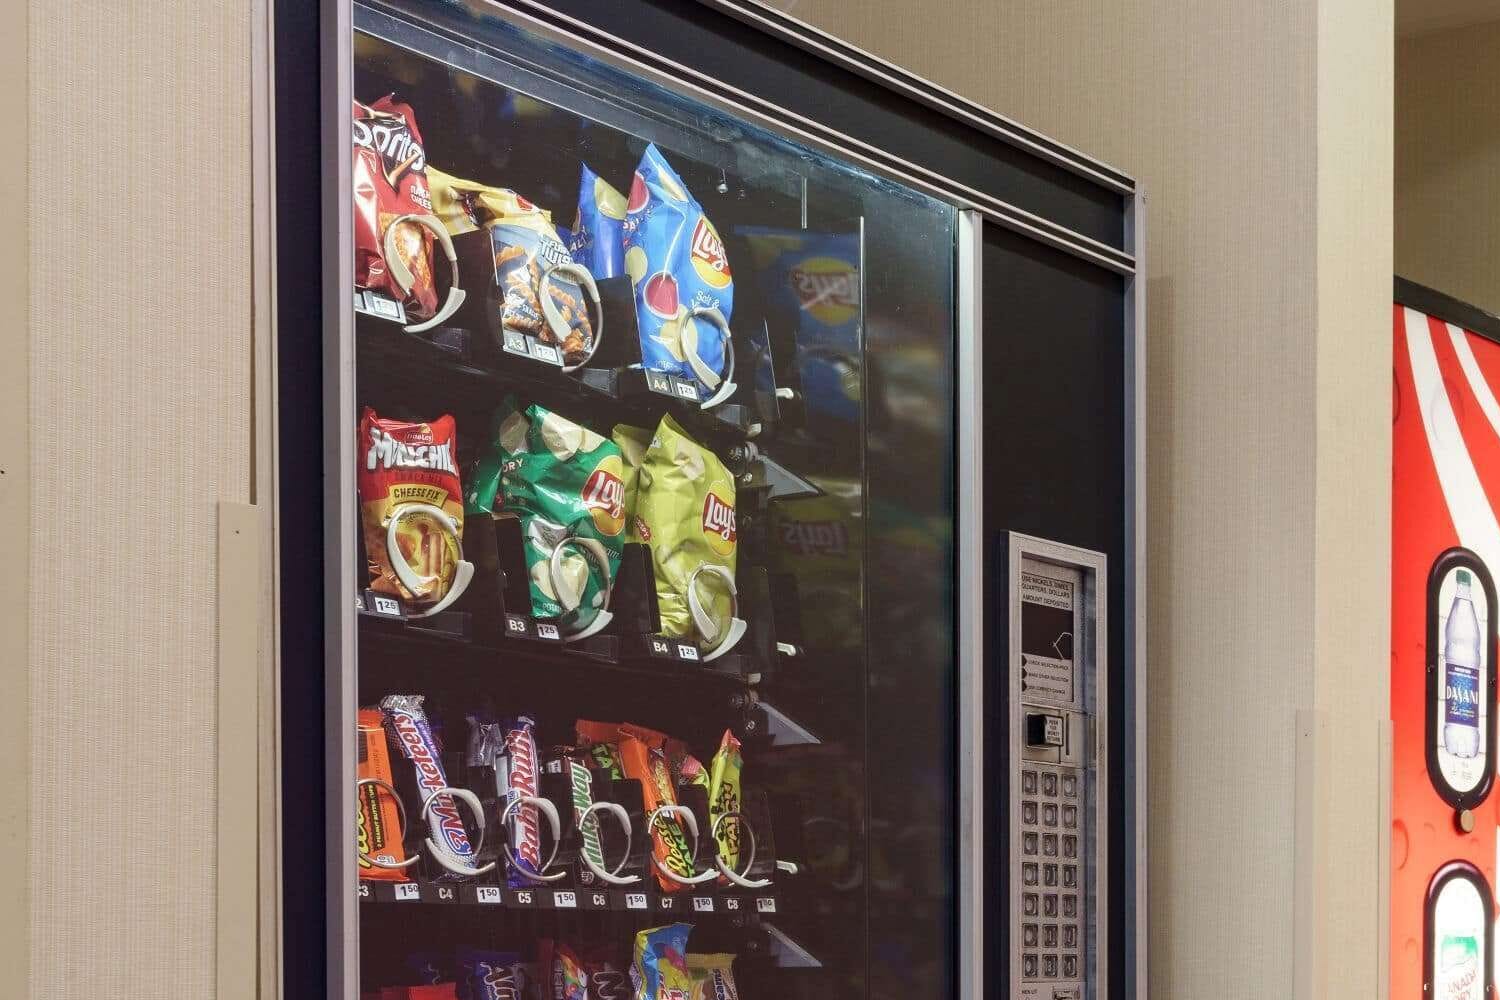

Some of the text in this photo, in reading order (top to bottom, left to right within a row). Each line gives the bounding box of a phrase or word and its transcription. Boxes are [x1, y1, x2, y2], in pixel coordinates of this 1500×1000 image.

[509, 619, 527, 632] B3
[653, 641, 668, 653] B4
[1446, 686, 1479, 705] DASANI
[438, 888, 454, 900] C4
[518, 893, 532, 903] C5
[593, 894, 606, 905] C6
[661, 899, 673, 908] C7
